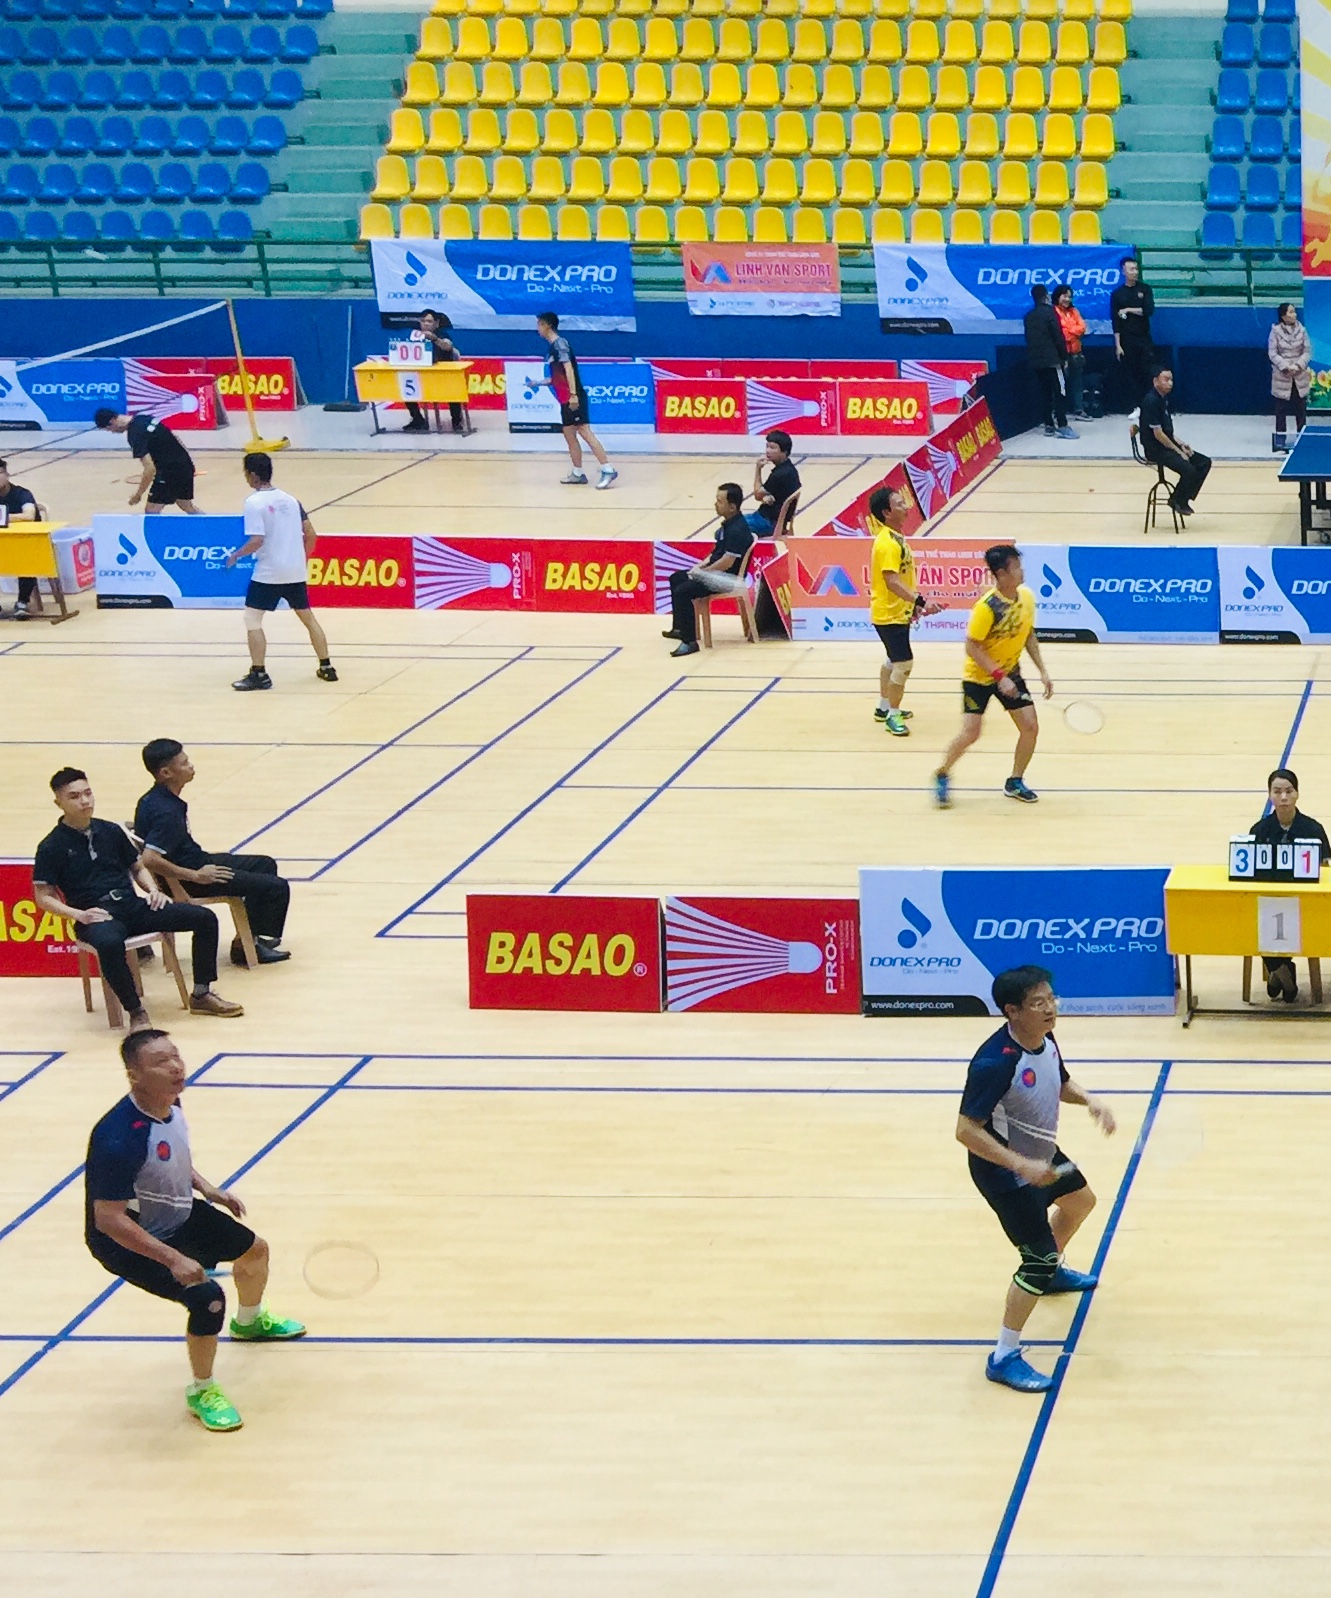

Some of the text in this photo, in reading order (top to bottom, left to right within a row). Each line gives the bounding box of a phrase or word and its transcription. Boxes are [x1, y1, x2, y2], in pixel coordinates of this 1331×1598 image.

[735, 263, 762, 276] LINH
[794, 263, 832, 277] SPORT
[217, 373, 284, 395] BASAO
[405, 379, 416, 396] 5
[468, 374, 506, 395] BAS
[664, 396, 736, 419] BASAO
[846, 397, 918, 420] BASAO
[308, 557, 399, 587] BASAO
[511, 552, 522, 600] PRO-X
[545, 562, 640, 592] BASAO
[1234, 849, 1312, 874] 3 0 0 1
[1271, 912, 1285, 941] 1
[485, 931, 636, 976] BASAO
[824, 921, 838, 994] PRO-X
[1041, 941, 1158, 954] Do Next Pro
[870, 1000, 954, 1012] www.donexpro.com
